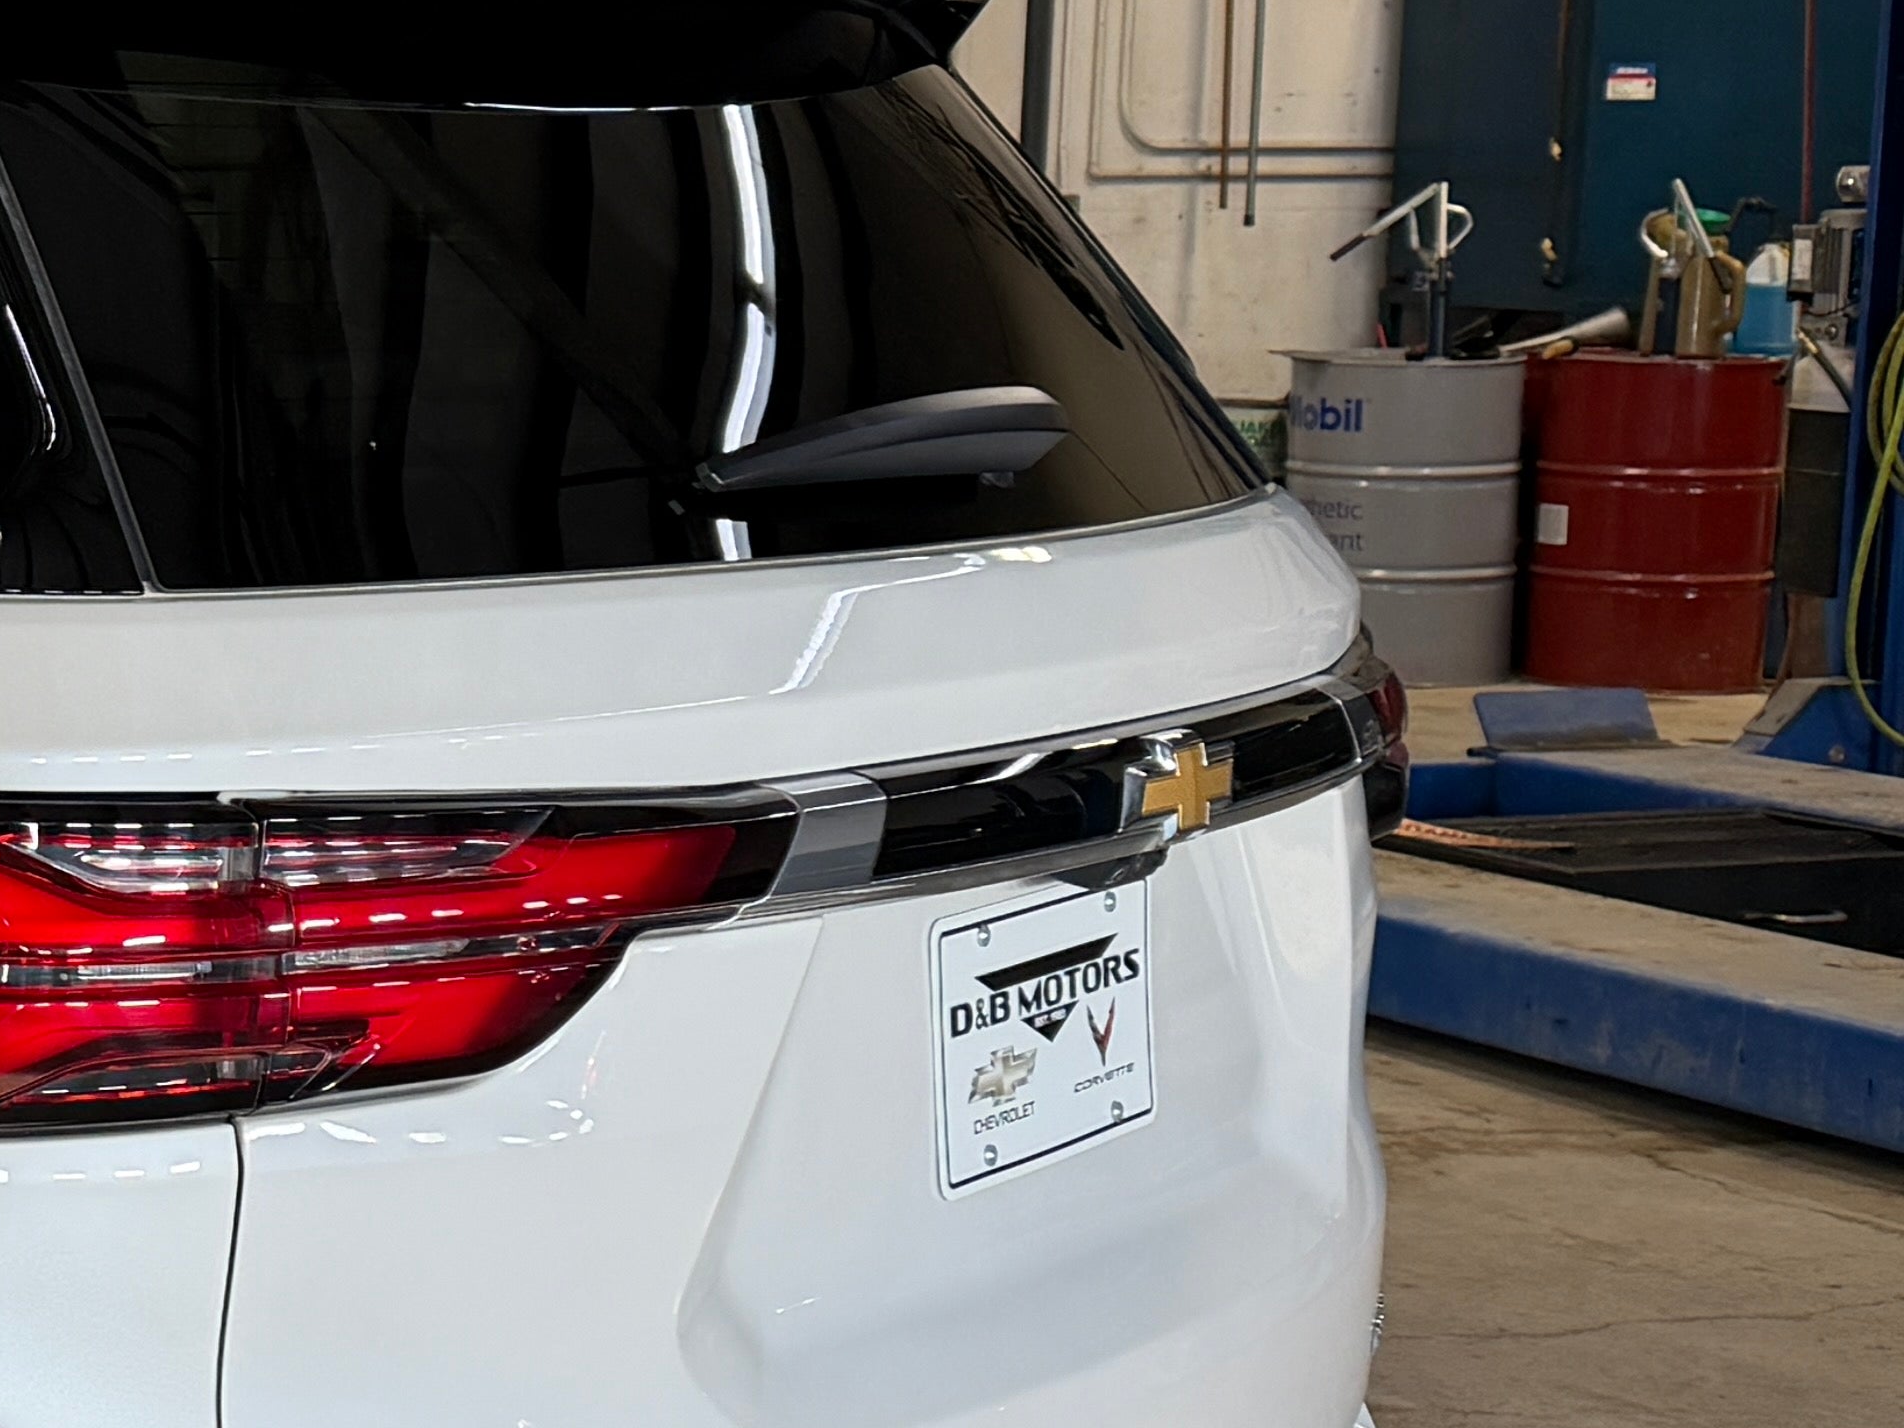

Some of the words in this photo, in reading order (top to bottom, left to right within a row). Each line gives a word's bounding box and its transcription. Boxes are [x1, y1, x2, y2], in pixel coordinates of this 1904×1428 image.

[950, 990, 1011, 1039] D&B
[1018, 948, 1140, 1016] MOTORS
[1073, 1062, 1135, 1093] CORVETTE
[973, 1100, 1036, 1135] CHEVROLET
